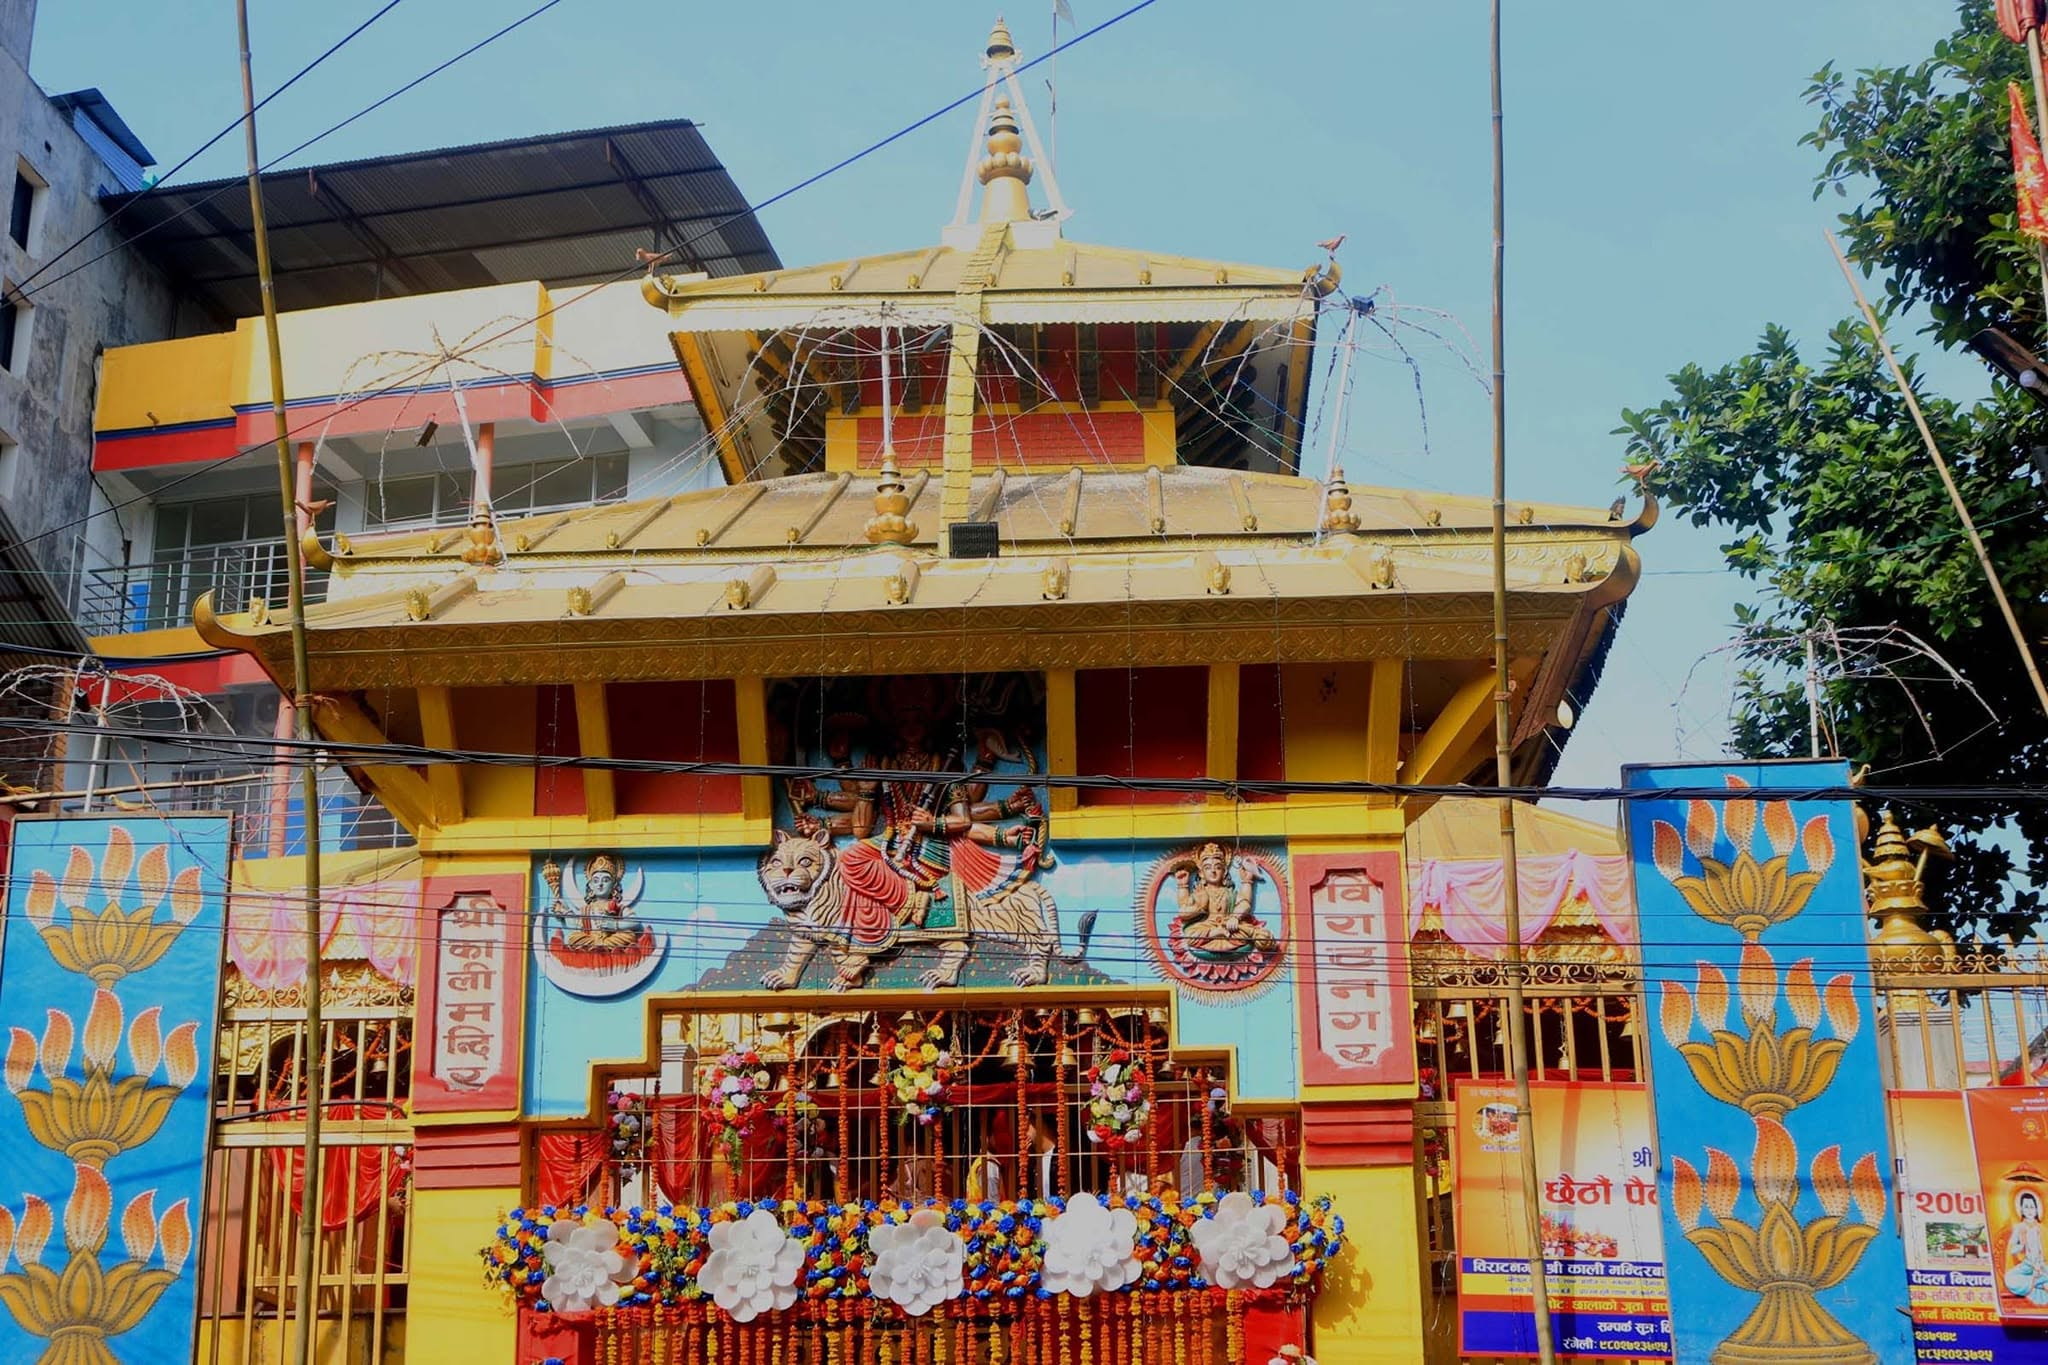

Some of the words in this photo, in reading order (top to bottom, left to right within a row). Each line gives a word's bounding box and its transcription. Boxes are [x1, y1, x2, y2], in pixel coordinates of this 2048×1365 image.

[451, 896, 496, 929] श्री
[447, 939, 497, 992] काली
[443, 1002, 495, 1088] मन्दिर
[1632, 1146, 1652, 1168] श्री
[1473, 1258, 1533, 1274] विराटनग
[1545, 1260, 1563, 1275] श्री
[1567, 1261, 1604, 1275] काली
